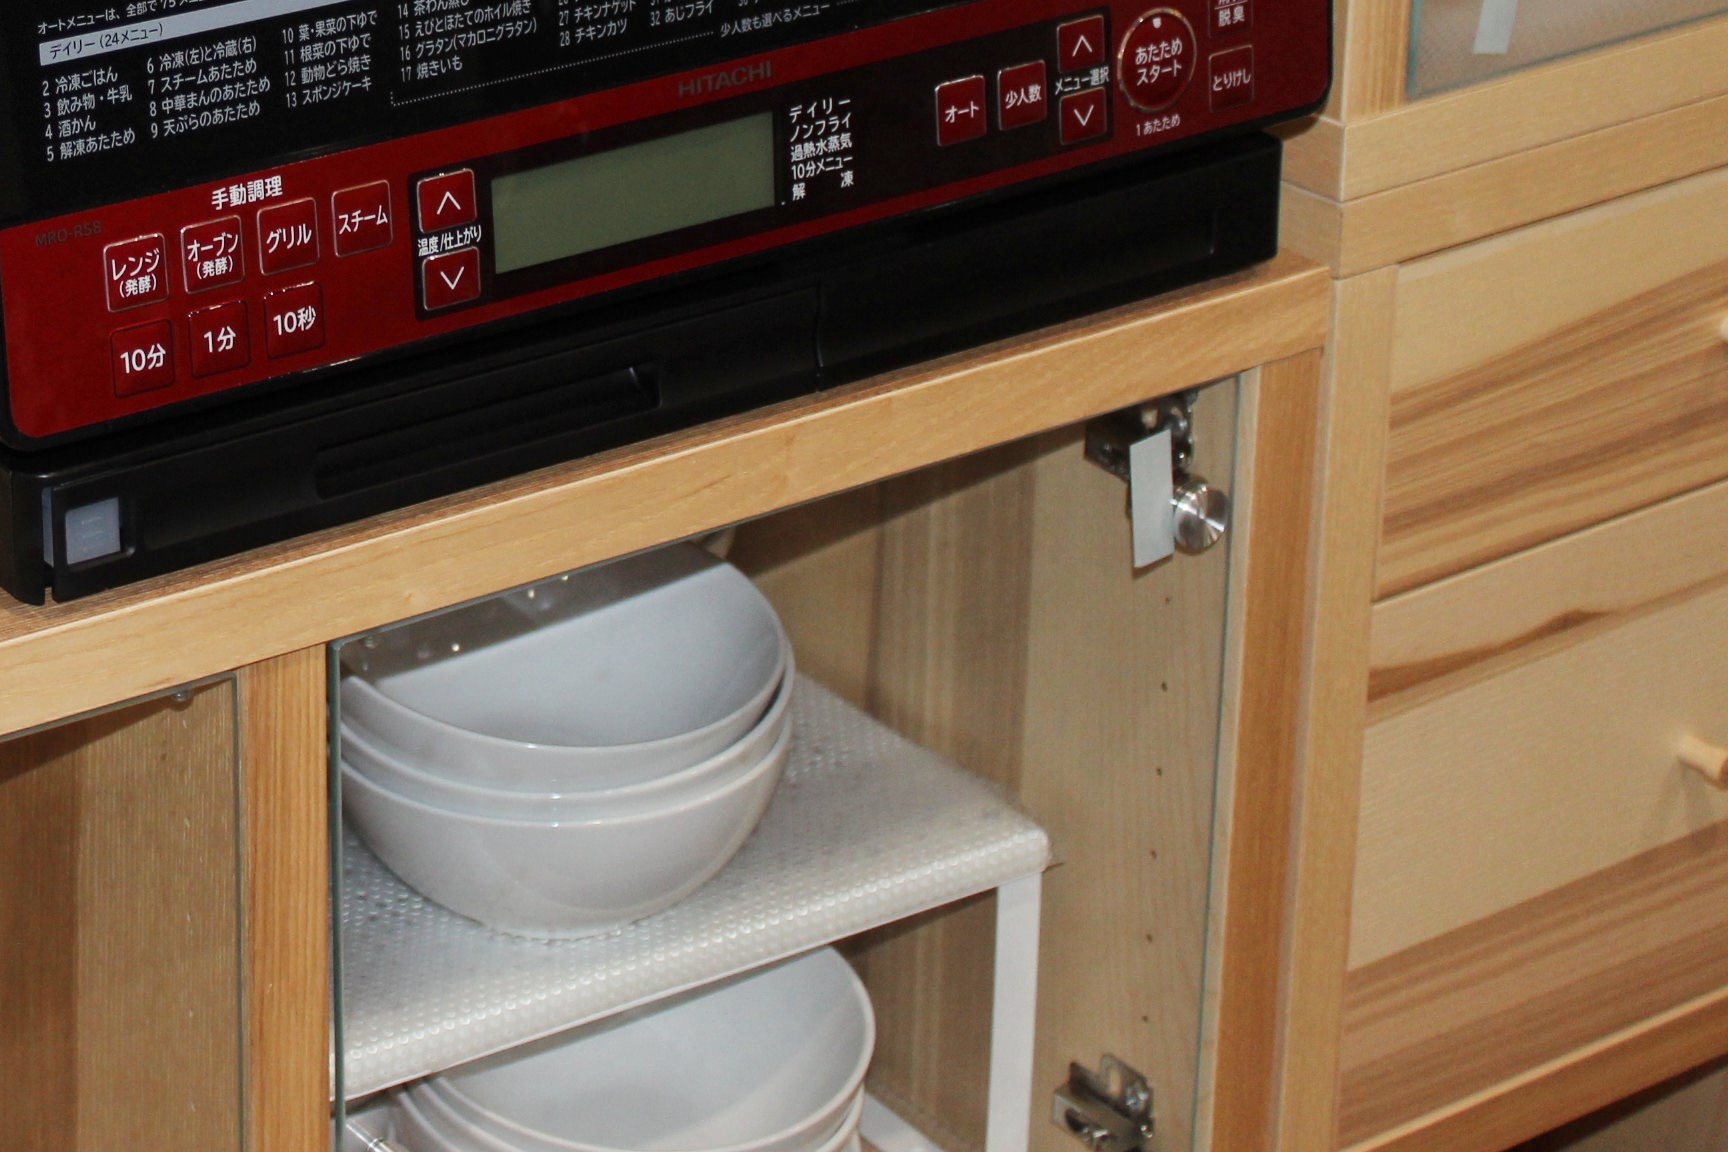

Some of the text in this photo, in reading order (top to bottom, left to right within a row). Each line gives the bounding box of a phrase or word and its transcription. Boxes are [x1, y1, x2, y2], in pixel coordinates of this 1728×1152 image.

[398, 3, 409, 19] 14
[559, 10, 569, 26] 27
[650, 11, 661, 26] 32
[721, 3, 830, 37] 少人数も選べるメニュー
[1218, 5, 1246, 27] 脱臭
[282, 28, 294, 44] 10
[399, 25, 410, 40] 15
[400, 18, 537, 62] 16 グラタン(マカロニグラタン)
[560, 18, 627, 47] 28 チキンカツ
[147, 35, 257, 74] 6 冷凍(左)と冷蔵(右)
[284, 50, 295, 65] 11
[1135, 38, 1183, 65] あたため
[42, 66, 119, 97] 2 冷凍ごはん
[148, 58, 257, 95] 7 スチームあたため
[285, 54, 372, 87] 12 動物どら焼き
[401, 55, 463, 82] 17 焼きいも
[678, 60, 772, 98] HITACHI
[1055, 66, 1110, 96] メニュー選択
[1137, 60, 1182, 85] スタート
[1212, 70, 1251, 91] とりけし
[150, 76, 271, 116] 8 中華まんのあたため
[286, 76, 372, 108] 13 スポンジケーキ
[1005, 84, 1042, 108] 少人数
[44, 103, 52, 118] 3
[151, 100, 261, 138] 9 天ぷらのあたため
[789, 98, 851, 123] デイリー
[945, 101, 979, 124] オート
[45, 115, 96, 140] 4 酒かん
[790, 113, 852, 143] ノンフライ
[47, 128, 136, 162] 5 解凍あたため
[791, 132, 853, 162] 過熱水蒸気
[791, 155, 854, 181] 10分メニュー
[211, 174, 283, 211] 手動調理
[34, 219, 103, 247] MRO-RS8
[338, 204, 388, 235] スチーム
[187, 232, 239, 262] オーブン
[266, 223, 312, 253] グリル
[417, 225, 482, 256] 温度/仕上がり
[112, 247, 160, 280] レンジ
[195, 255, 234, 280] (発酵)
[118, 272, 157, 299] (発酵)
[273, 305, 317, 338] 10秒
[203, 325, 236, 354] 1分
[120, 343, 167, 374] 10分
